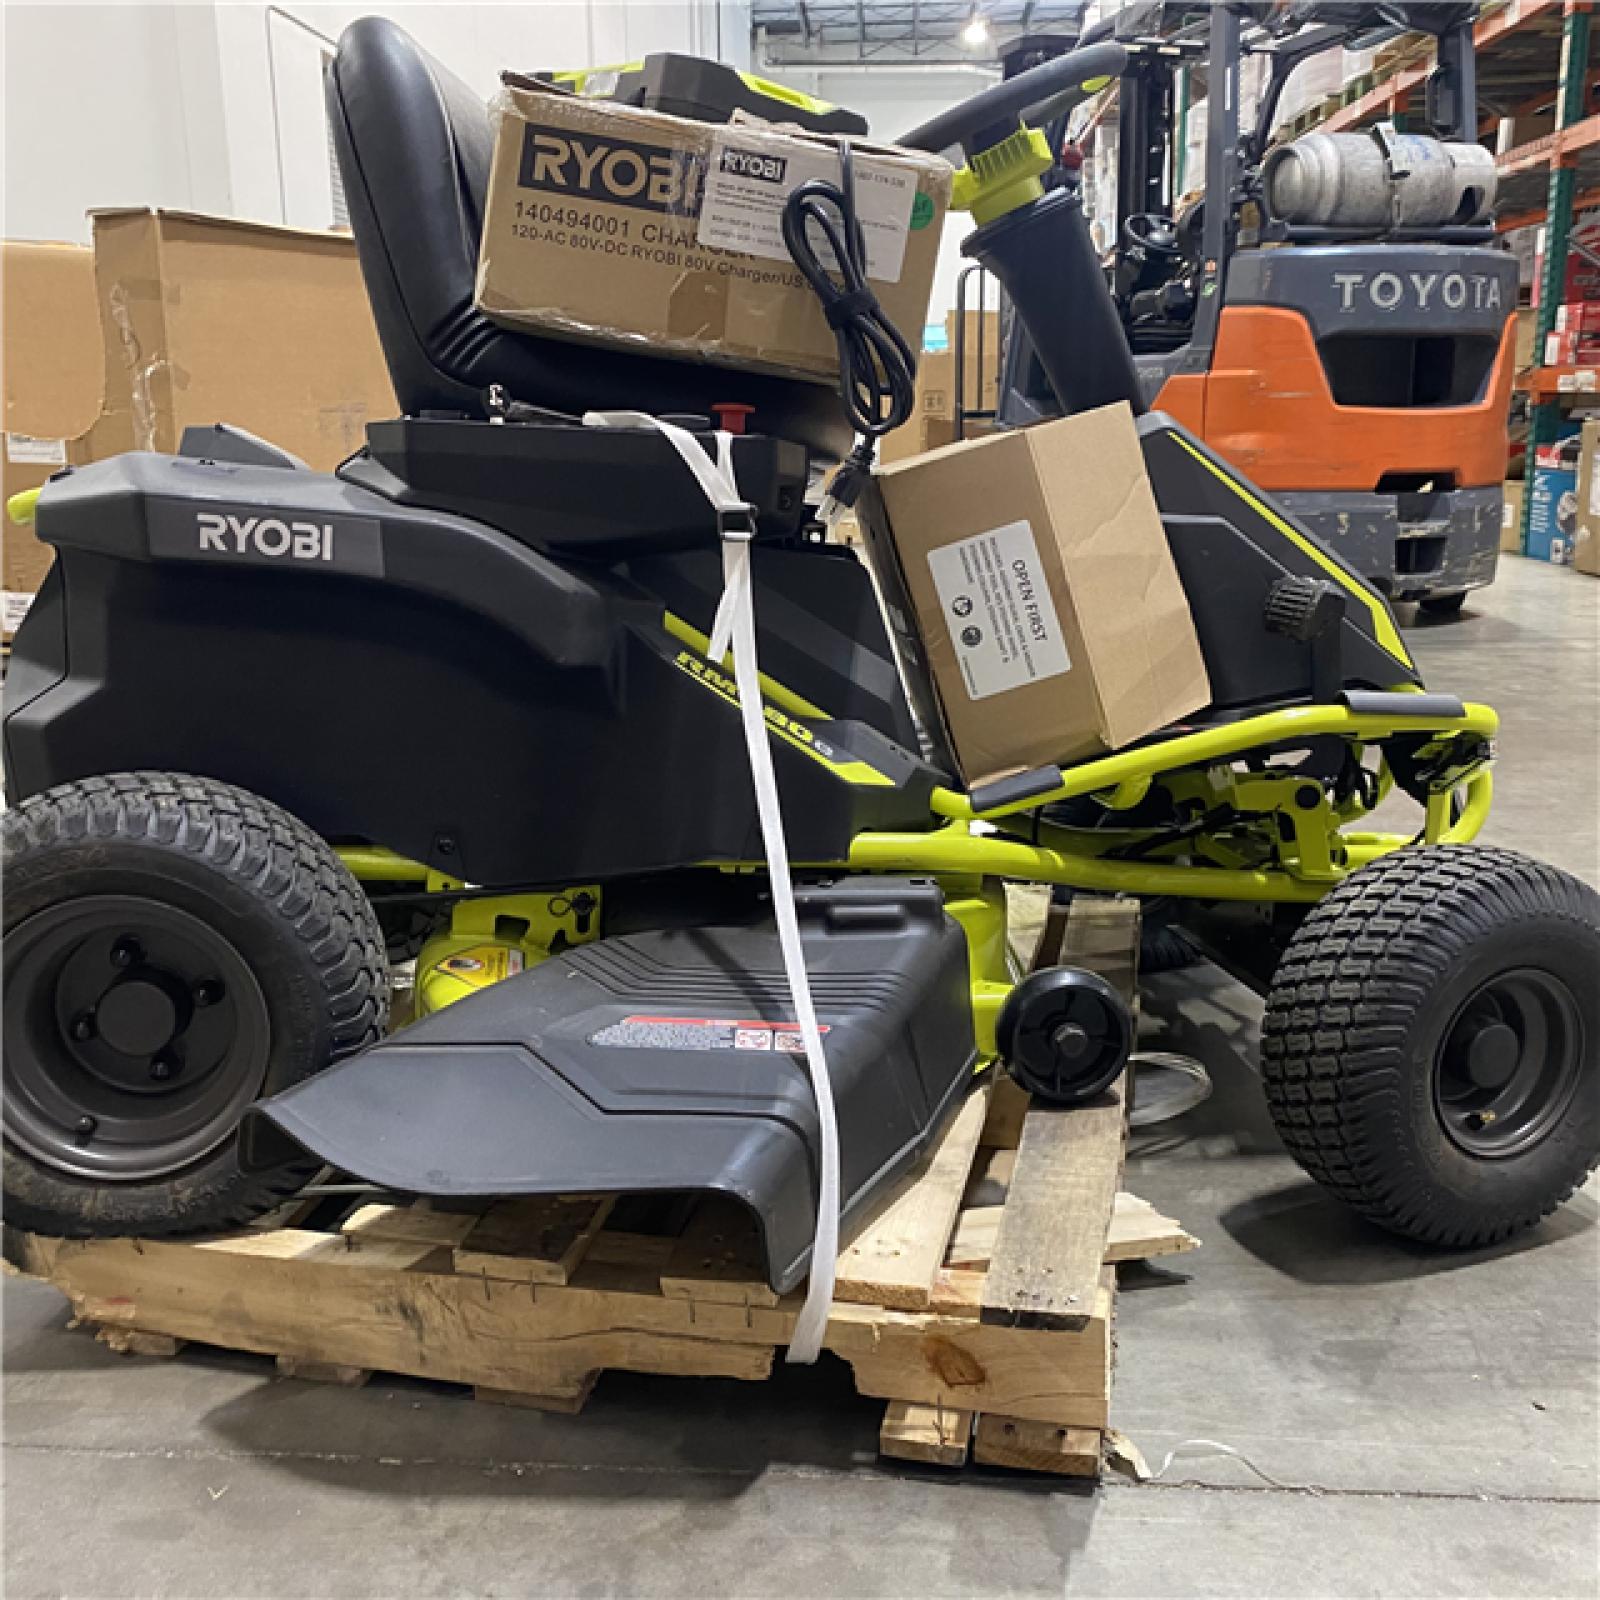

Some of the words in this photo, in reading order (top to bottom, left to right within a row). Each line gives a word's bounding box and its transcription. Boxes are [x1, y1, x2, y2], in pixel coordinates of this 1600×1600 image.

[532, 134, 697, 208] RYOBI
[723, 151, 783, 180] RYOBI
[515, 200, 630, 237] 140494001
[511, 224, 566, 245] 120-AC
[631, 244, 681, 266] RYOBI
[684, 254, 715, 272] 80V
[1334, 271, 1501, 309] TOYOTA
[196, 512, 333, 561] RYOBI
[1012, 559, 1035, 601] OPEN
[1025, 602, 1048, 641] FIRST
